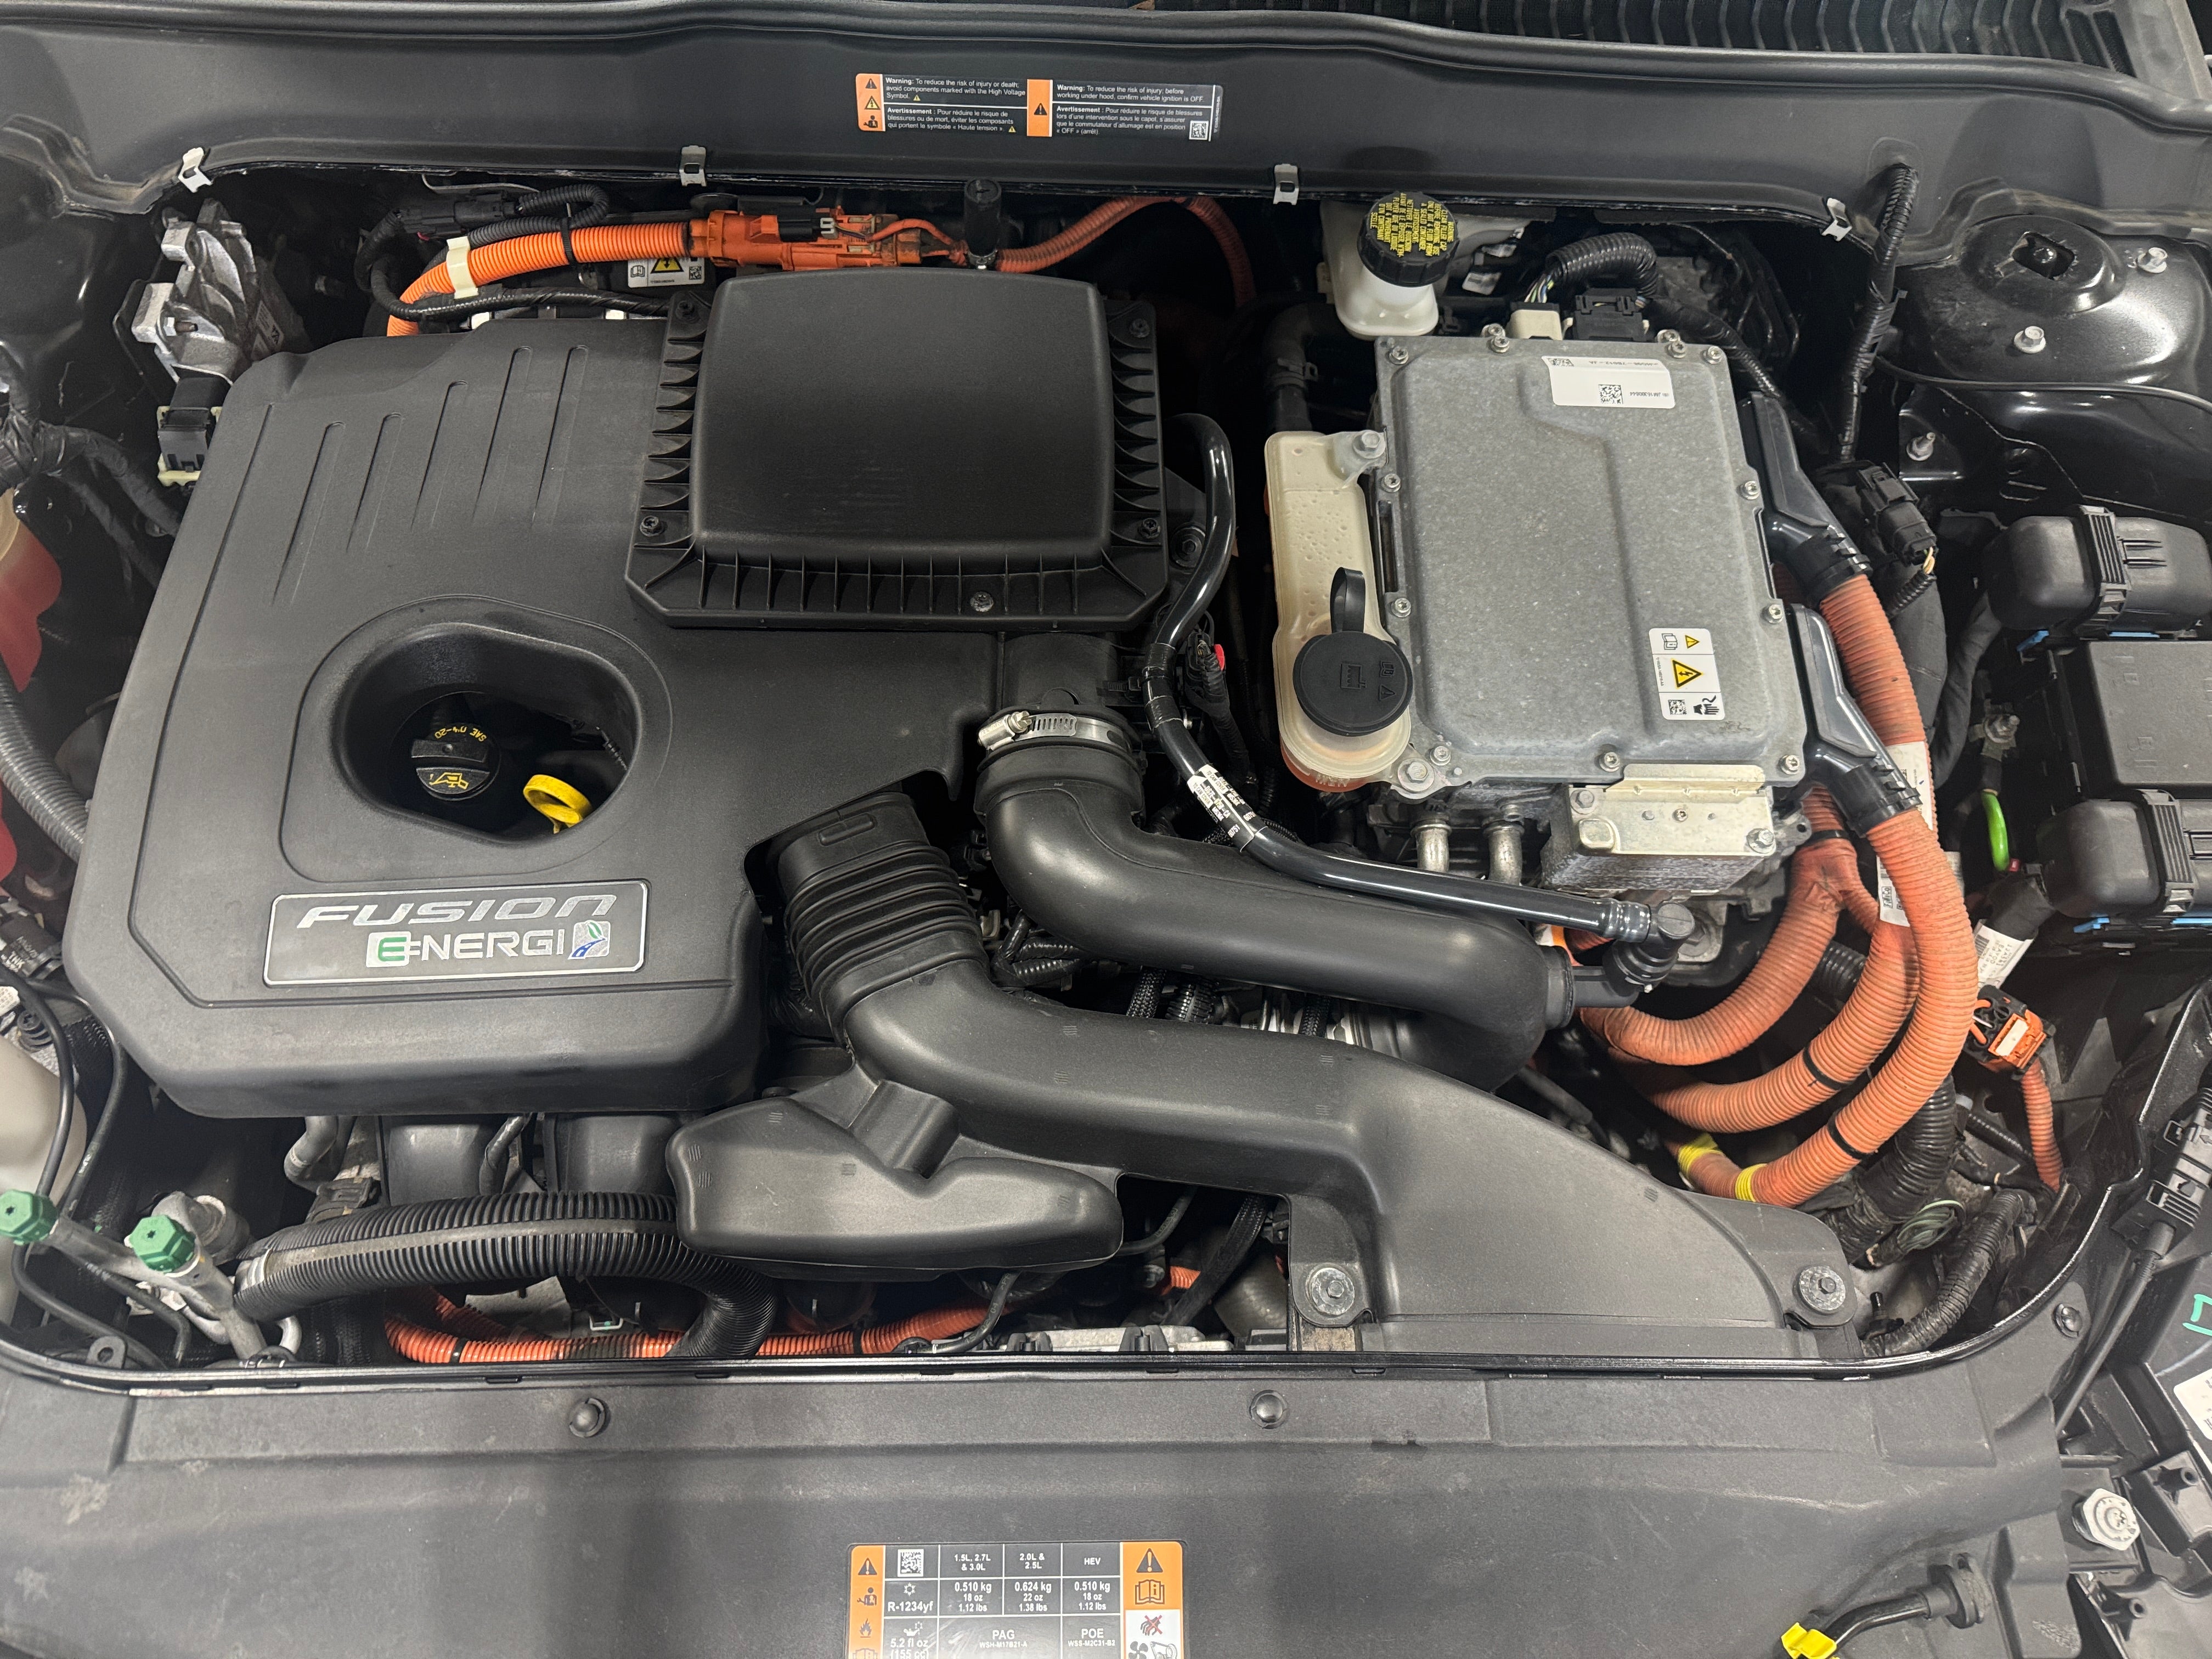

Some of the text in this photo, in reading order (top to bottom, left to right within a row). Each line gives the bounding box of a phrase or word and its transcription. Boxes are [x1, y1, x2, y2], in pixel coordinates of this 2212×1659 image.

[470, 727, 487, 742] SAE
[296, 894, 617, 929] FUSION
[377, 929, 565, 962] ENERGI
[955, 1554, 973, 1562] 1.5L,
[1025, 1561, 1042, 1570] 2.5L
[955, 1582, 992, 1593] 0.510 kg
[1015, 1582, 1052, 1593] 0.624 kg
[1075, 1581, 1110, 1593] 0.510 kg
[1024, 1593, 1032, 1601] 22
[888, 1600, 933, 1613] R-1234yf
[959, 1603, 987, 1612] 1.12 lbs
[1019, 1604, 1034, 1612] 1.38
[992, 1629, 1015, 1640] PAG
[1081, 1628, 1104, 1638] POE
[890, 1638, 906, 1648] 5.2
[908, 1638, 914, 1647] fl
